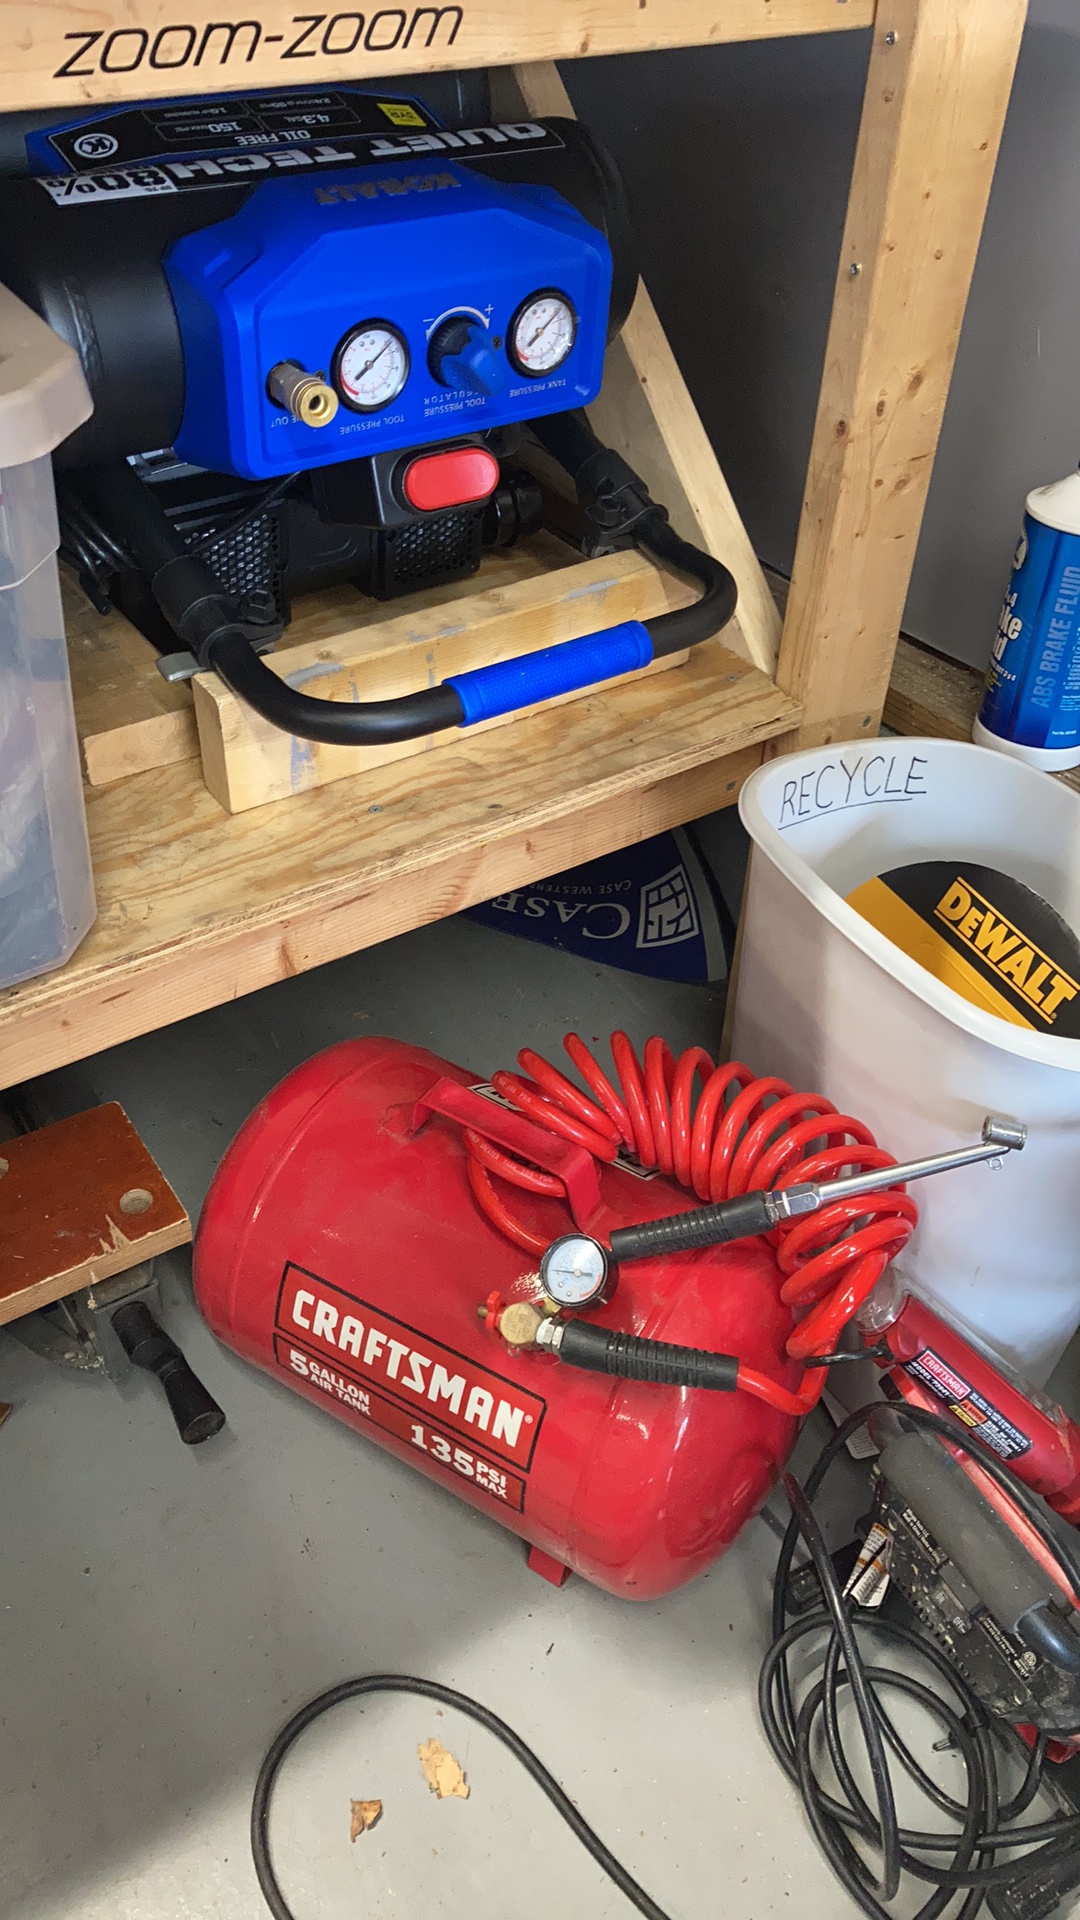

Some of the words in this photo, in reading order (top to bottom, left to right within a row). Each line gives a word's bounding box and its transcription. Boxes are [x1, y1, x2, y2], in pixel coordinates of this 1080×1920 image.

[53, 5, 463, 78] zoom-zoom
[234, 131, 278, 146] FREE
[278, 129, 310, 142] OIL
[369, 122, 547, 156] QUIET
[165, 145, 356, 179] TECH
[314, 172, 461, 205] KOBALT
[508, 381, 550, 398] PRESSURE
[549, 378, 567, 388] TANK
[424, 390, 479, 405] GULATOR
[424, 399, 463, 417] PRESSURE
[465, 397, 486, 409] TOOL
[270, 416, 289, 428] OUT
[339, 418, 381, 436] PRESSURE
[383, 414, 405, 425] TOOL
[1053, 564, 1080, 616] FLUID
[1038, 616, 1071, 674] BRAKE
[1030, 673, 1056, 708] ABS
[779, 756, 928, 823] RECYCLE
[598, 879, 632, 895] CASE
[289, 1349, 309, 1377] 5
[309, 1362, 370, 1405] GALLON
[292, 1289, 525, 1448] CRAFTSMAN
[910, 1360, 932, 1380] MODEL
[922, 1355, 966, 1396] CRAFTSMAN
[310, 1373, 332, 1393] AIR
[337, 1388, 371, 1416] TANK
[410, 1425, 474, 1477] 135
[476, 1460, 507, 1489] PSI
[476, 1474, 507, 1500] MAX
[951, 1615, 965, 1629] OFF
